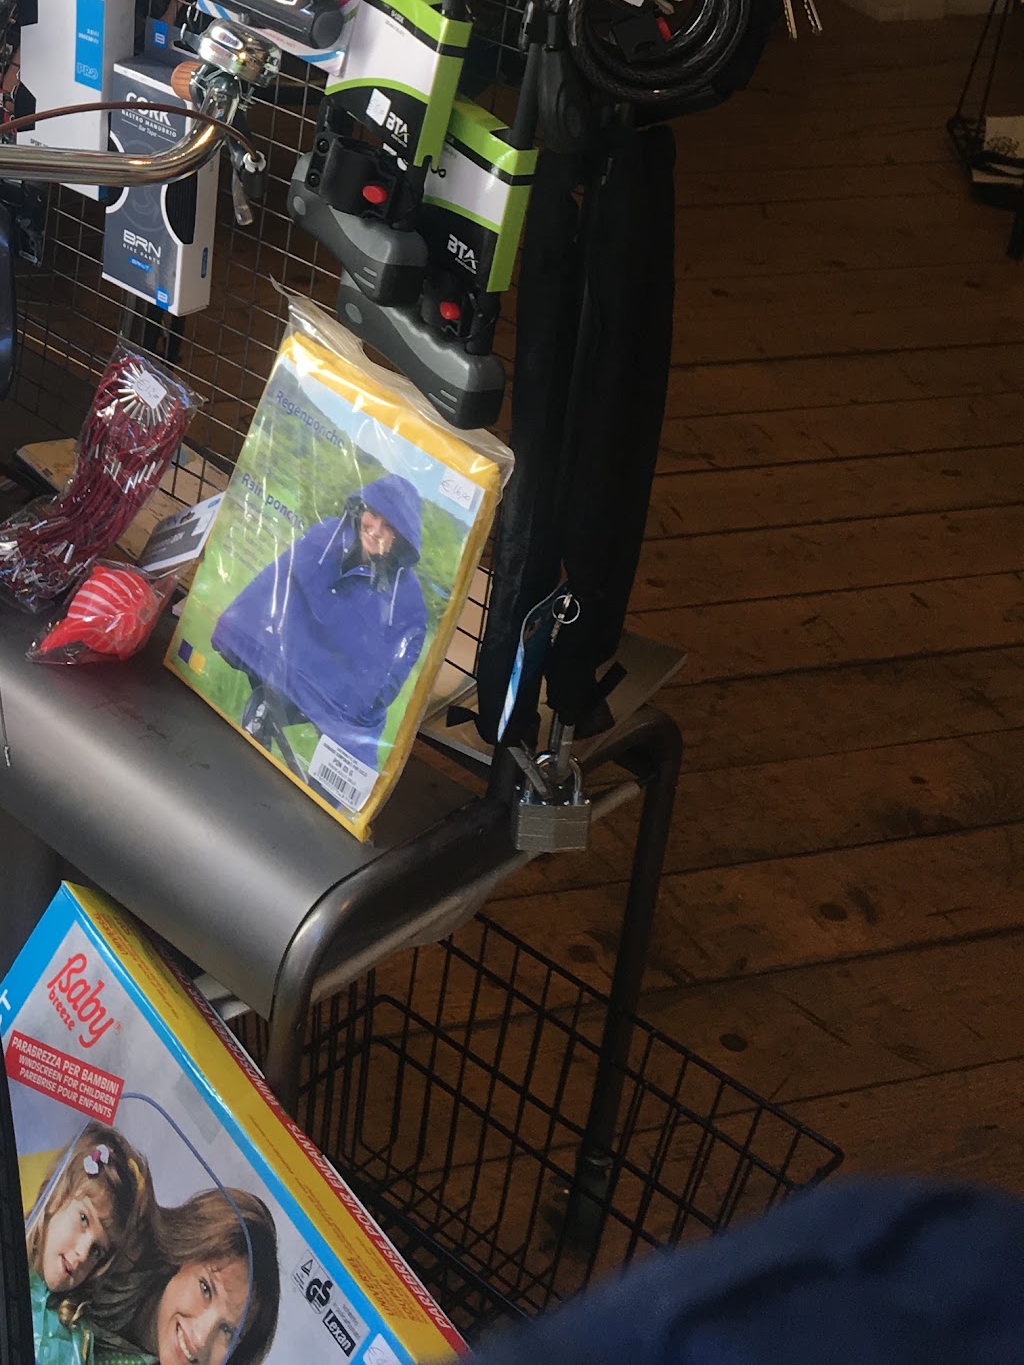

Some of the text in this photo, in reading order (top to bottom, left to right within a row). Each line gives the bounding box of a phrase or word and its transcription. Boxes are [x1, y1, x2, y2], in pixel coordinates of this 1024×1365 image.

[144, 120, 177, 138] MANUBRIO
[386, 112, 410, 142] BTA
[123, 243, 161, 264] BIKE PARTS
[124, 229, 162, 257] BRN
[448, 234, 477, 267] BTA
[47, 953, 115, 1049] Baby
[48, 986, 76, 1032] breeze
[11, 1036, 120, 1096] PARABREZZA PER BAMBINI
[18, 1054, 116, 1107] WINDSCREEN FOR CHILDREN
[19, 1068, 113, 1118] PAREBRISE POUR ENFANTS
[287, 1121, 346, 1193] ENFANTS
[341, 1191, 380, 1236] POUR
[306, 1278, 333, 1306] GS
[375, 1234, 451, 1330] PAREBRISE
[325, 1314, 353, 1352] Lexan
